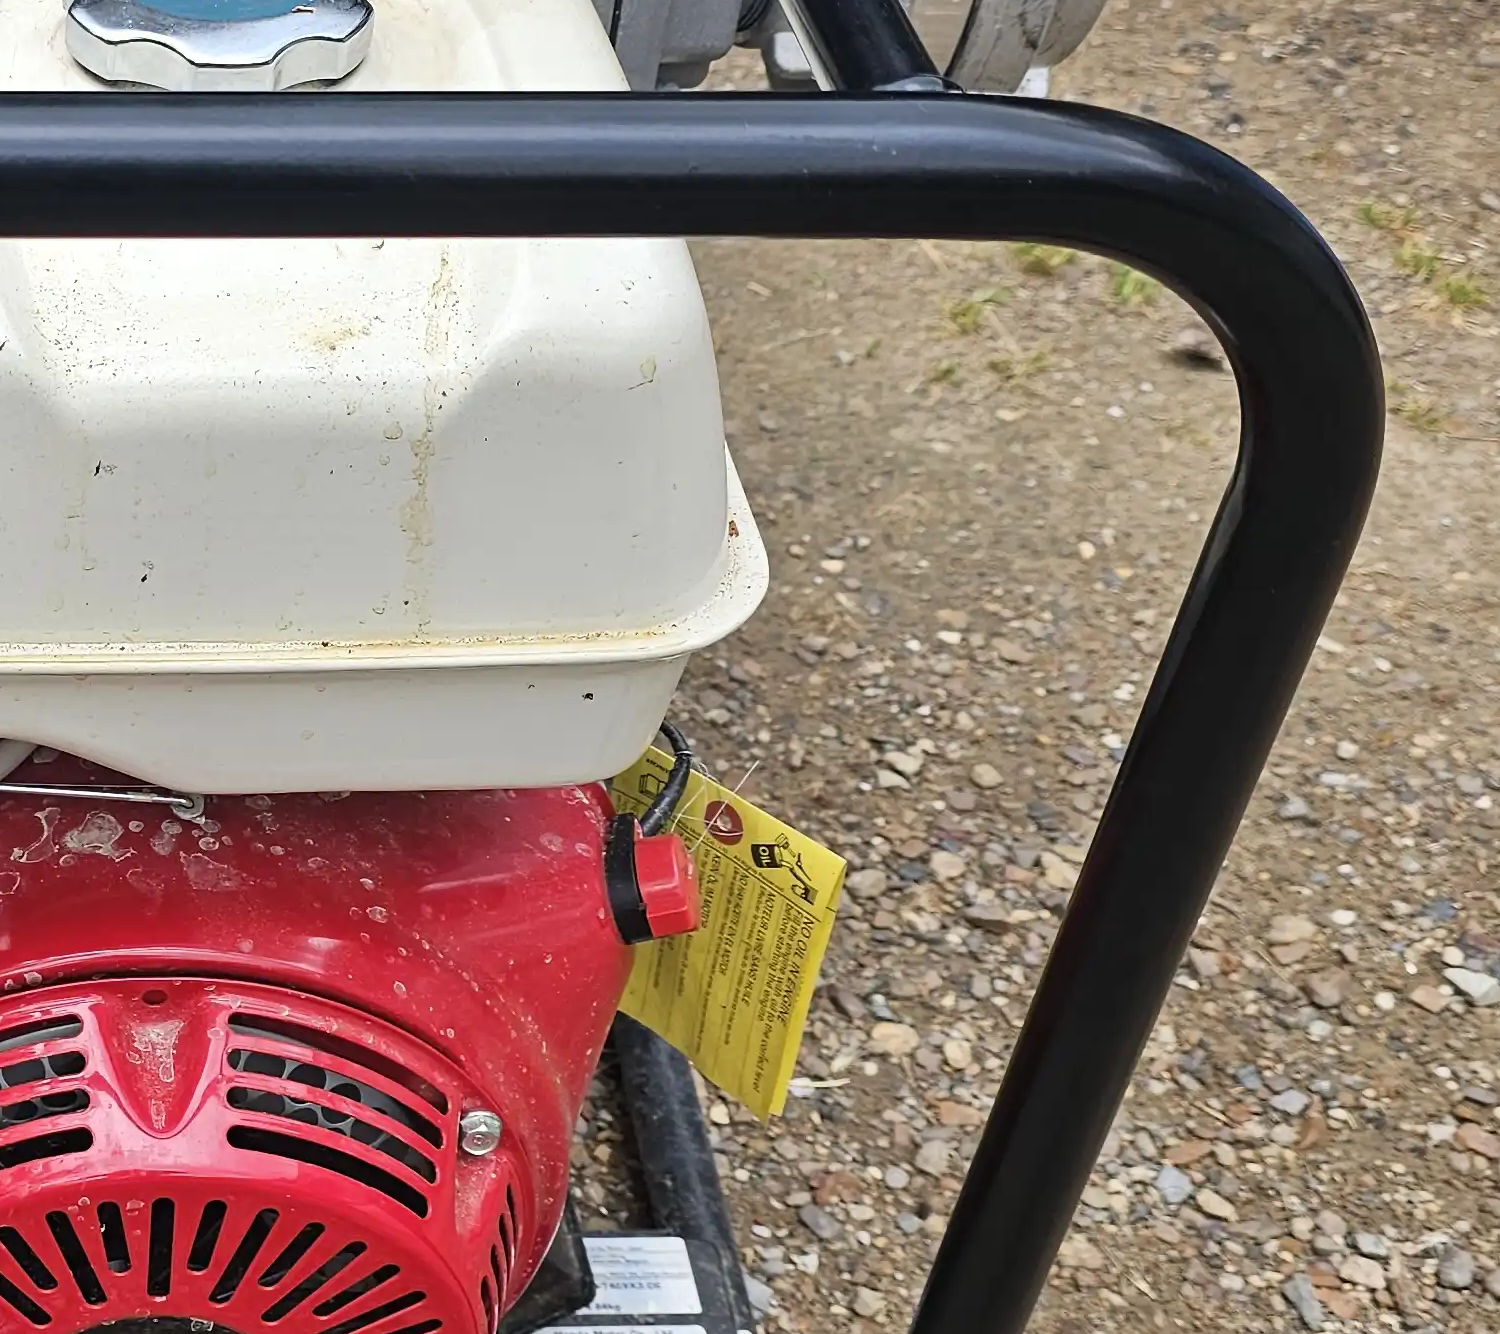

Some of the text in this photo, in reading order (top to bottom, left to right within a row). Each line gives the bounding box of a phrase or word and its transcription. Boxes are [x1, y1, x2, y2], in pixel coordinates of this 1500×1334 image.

[759, 845, 772, 867] OIL
[760, 892, 775, 929] MOTEUR
[780, 903, 793, 933] before
[787, 925, 797, 941] the
[748, 955, 759, 980] SANS
[769, 935, 784, 971] starting
[779, 942, 791, 974] engine
[777, 916, 813, 1022] NO OIL IN ENGINE
[741, 980, 753, 1005] HUILE
[773, 976, 783, 996] with
[758, 989, 769, 1021] engine
[756, 1039, 767, 1070] correct
[753, 1072, 762, 1092] level
